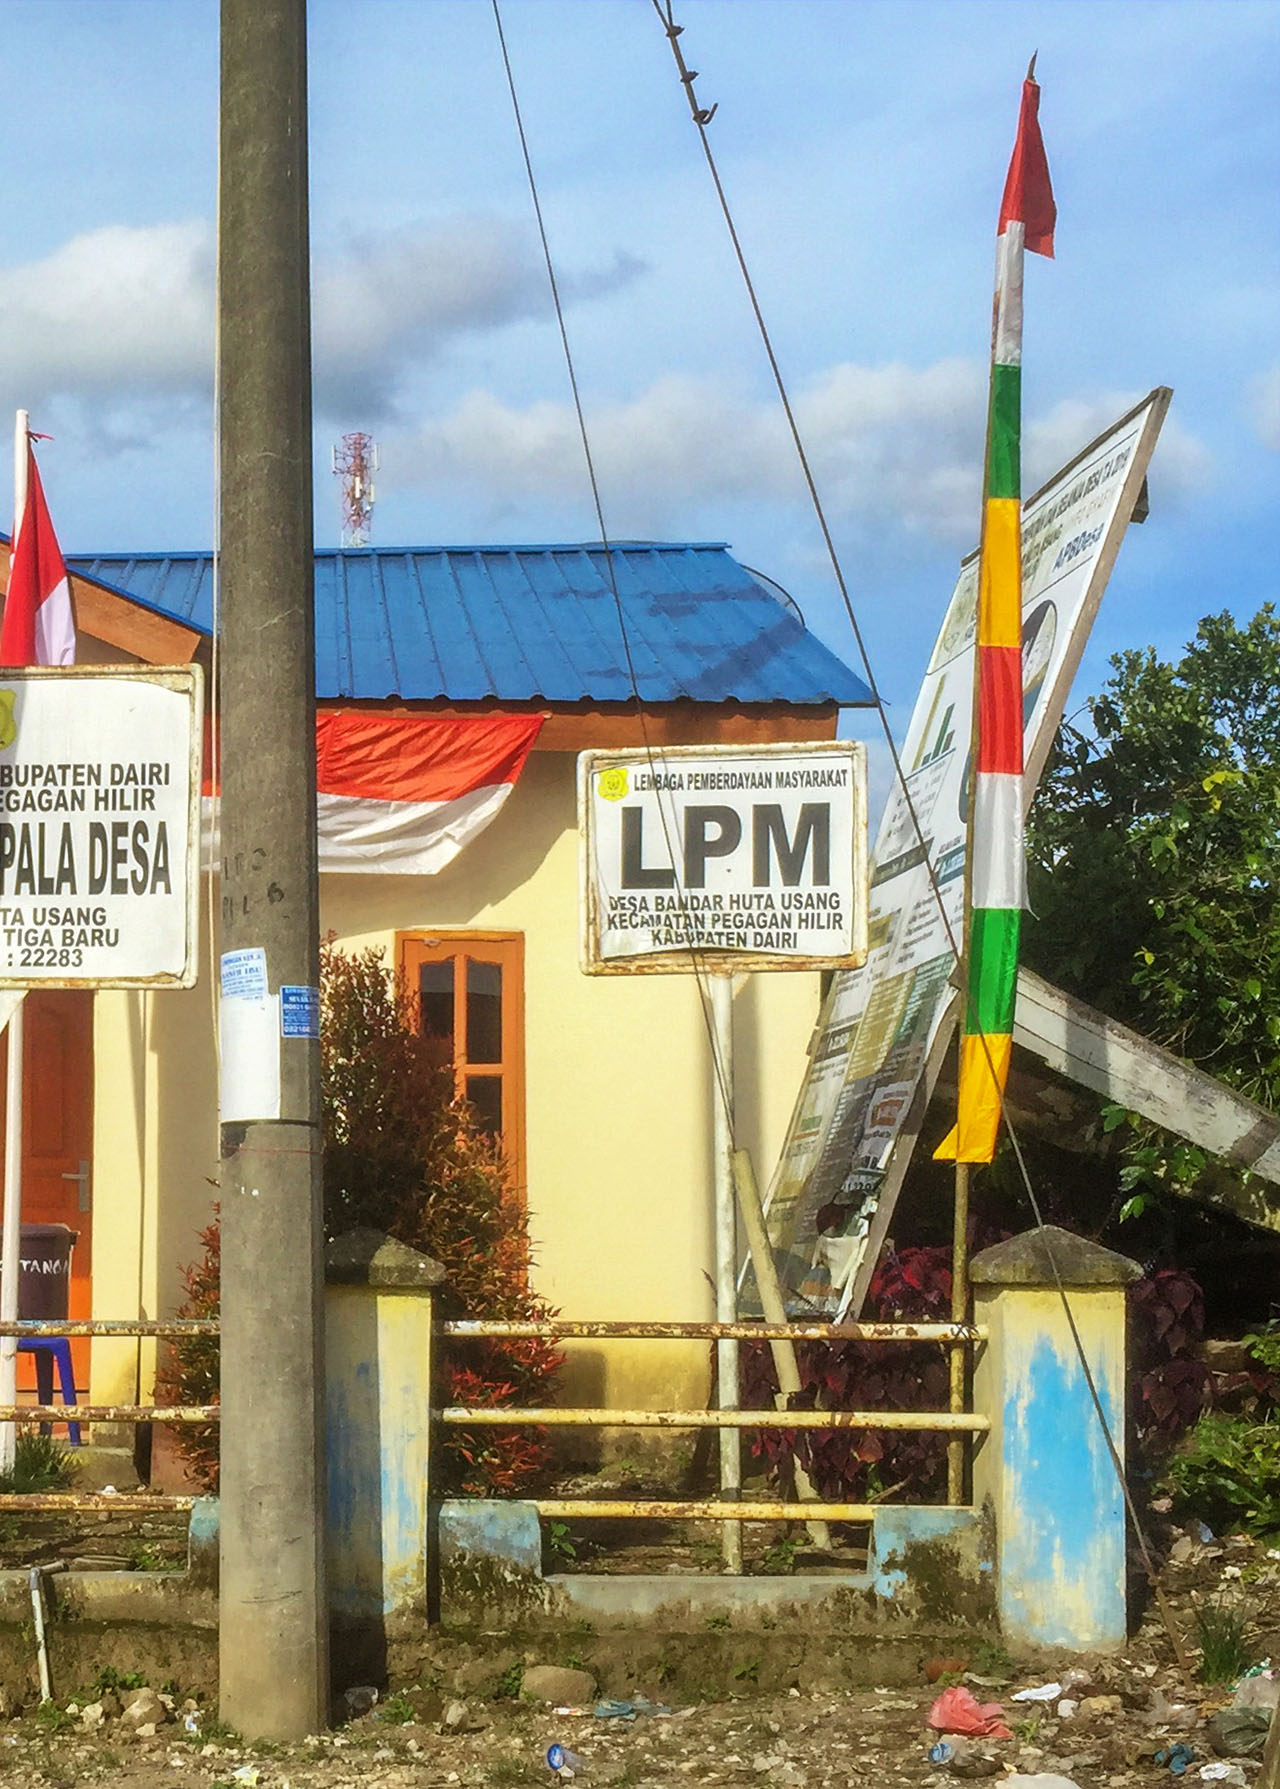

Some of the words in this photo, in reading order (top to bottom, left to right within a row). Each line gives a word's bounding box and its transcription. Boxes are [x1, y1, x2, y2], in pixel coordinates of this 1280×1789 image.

[110, 763, 170, 786] DAIRI
[634, 772, 685, 792] LEMBAGA
[687, 771, 771, 791] PEMBERDAYAAN
[775, 769, 848, 789] MASYARAKAT
[94, 788, 156, 811] HILIR
[621, 802, 831, 890] LPM
[88, 820, 172, 896] DESA
[610, 896, 649, 913] DESA
[654, 894, 724, 912] BANDAR
[729, 893, 776, 910] HUTA
[781, 892, 840, 910] USANG
[32, 907, 107, 926] USANG
[608, 912, 705, 931] KECAMATAN
[711, 912, 792, 930] PEGAGAN
[797, 912, 843, 930] HILIR
[3, 928, 54, 948] TIGA
[61, 928, 119, 948] BARU
[652, 928, 747, 948] KABUPATEN
[753, 931, 798, 949] DAIRI
[20, 949, 83, 967] 22283
